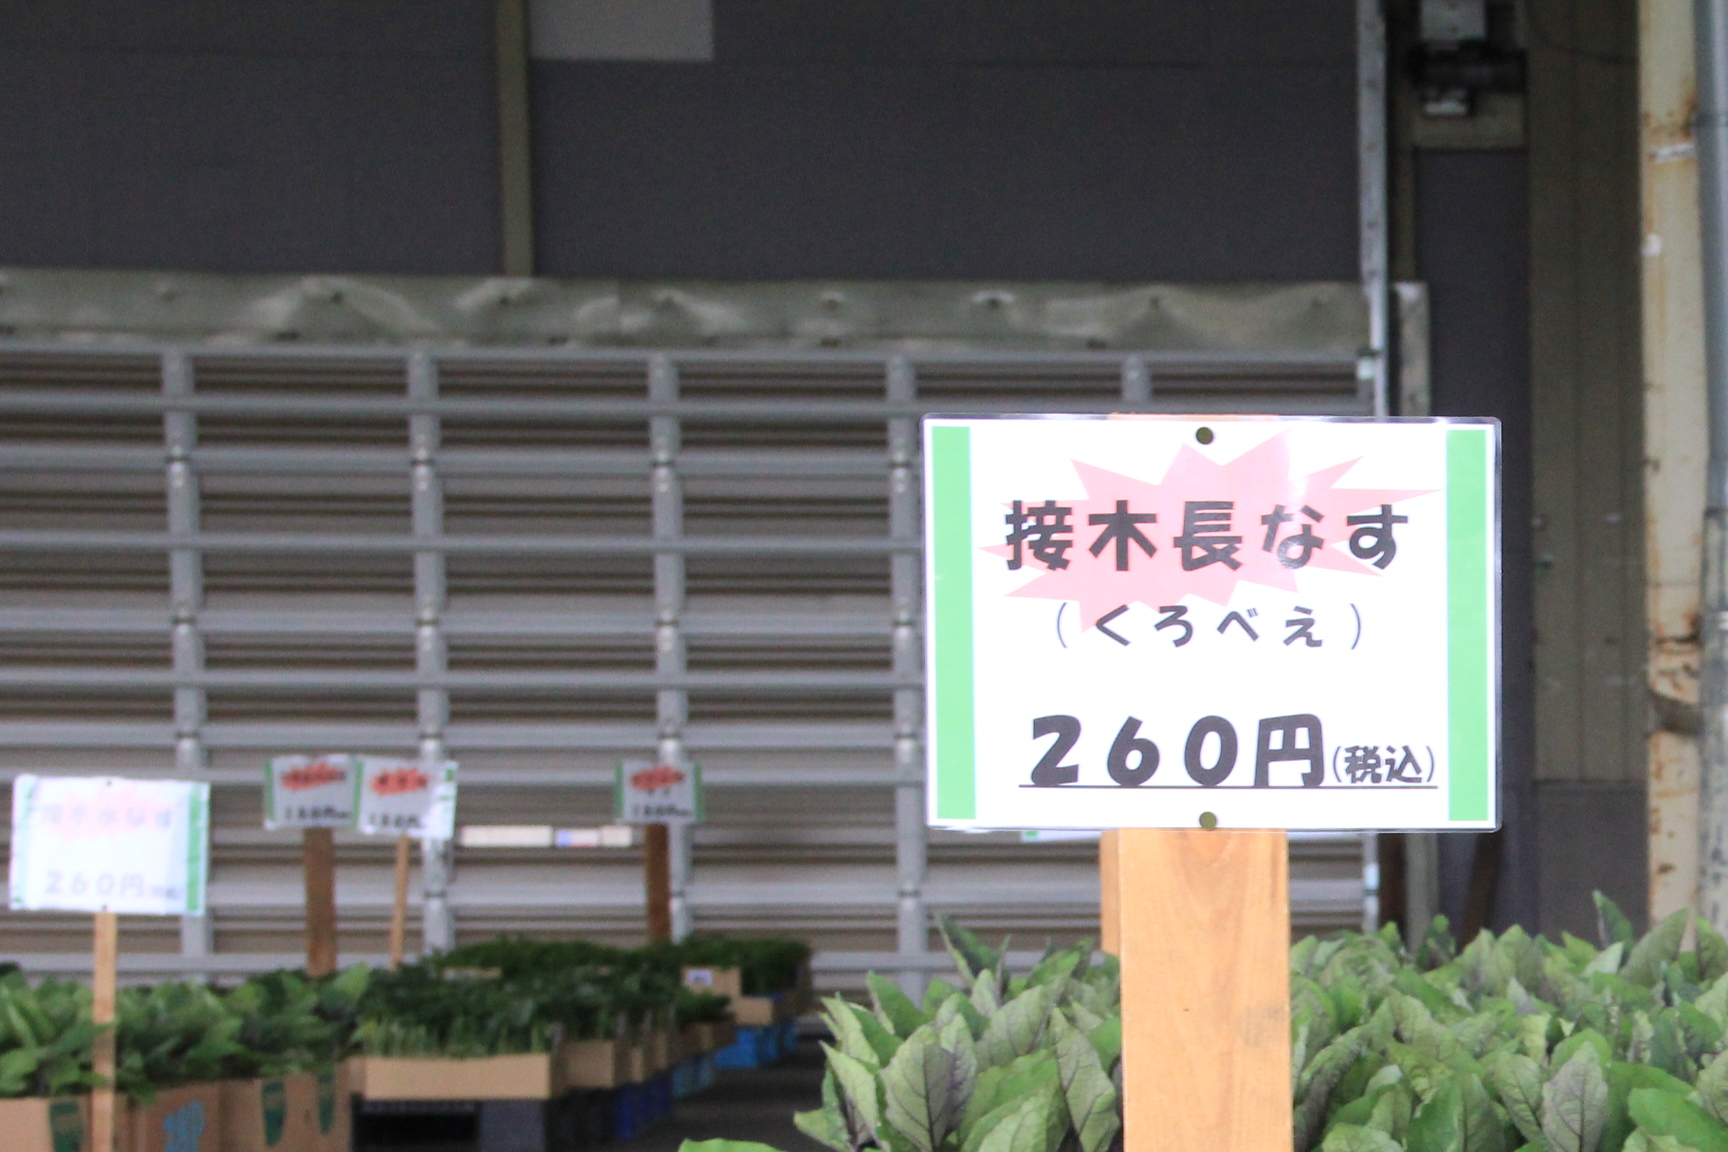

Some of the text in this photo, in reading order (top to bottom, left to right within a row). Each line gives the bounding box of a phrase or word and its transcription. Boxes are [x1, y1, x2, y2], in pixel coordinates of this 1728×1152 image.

[1004, 499, 1409, 572] 接木長なす
